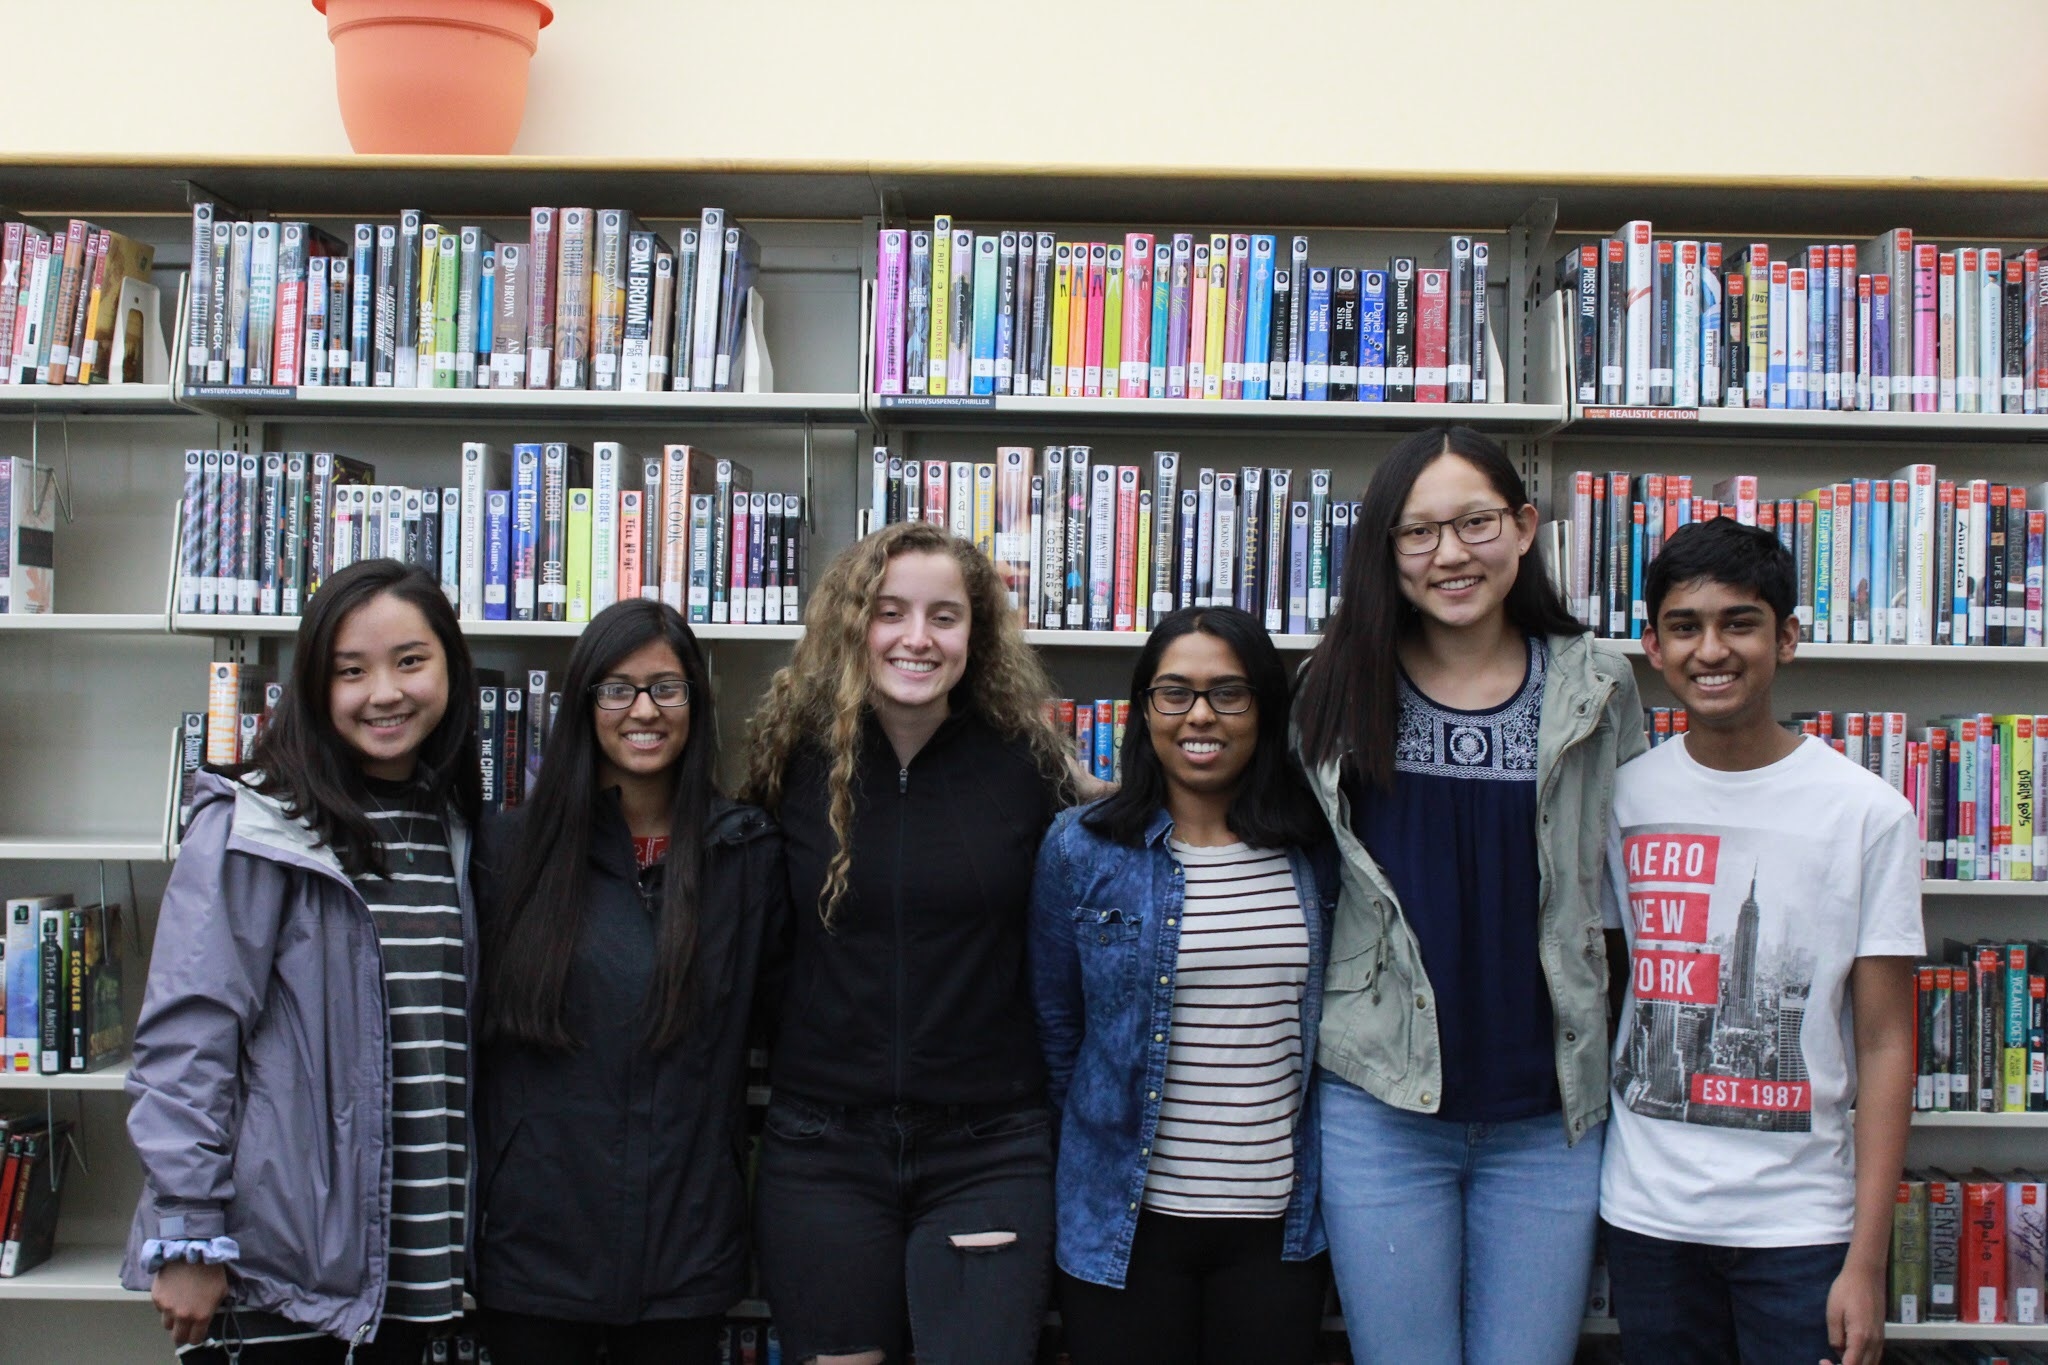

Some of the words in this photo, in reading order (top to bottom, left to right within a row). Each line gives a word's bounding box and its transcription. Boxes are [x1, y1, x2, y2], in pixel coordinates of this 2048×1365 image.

[563, 239, 583, 277] BROWN
[631, 252, 649, 274] AN
[937, 252, 945, 275] RUFF
[503, 264, 516, 284] DAN
[602, 251, 617, 302] BROWN
[1474, 280, 1485, 296] RED
[1582, 267, 1596, 294] PRESS
[2038, 265, 2048, 308] BIFOCAL
[76, 289, 88, 312] Great
[213, 266, 224, 312] REALITY
[283, 286, 297, 301] THE
[354, 274, 370, 303] COLD
[376, 293, 385, 311] LOVE
[459, 289, 472, 313] TONY
[503, 284, 515, 318] BROWN
[563, 290, 581, 302] LOST
[628, 276, 648, 325] BROWN
[1397, 280, 1408, 309] Daniel
[1750, 292, 1769, 304] JUST
[191, 292, 208, 320] KEITH
[282, 304, 296, 328] DOUBT
[385, 294, 395, 335] ASSASSIN'S
[558, 304, 586, 316] SYMBOL
[936, 297, 944, 315] BAD
[1003, 266, 1012, 360] REVOLVE
[1289, 297, 1299, 334] SHADOW
[1318, 303, 1328, 332] Daniel
[1336, 306, 1346, 330] Silva
[1344, 300, 1354, 330] Daniel
[1373, 302, 1384, 333] Daniel
[1423, 308, 1433, 330] Silva
[1433, 299, 1444, 330] Daniel
[1475, 302, 1486, 324] BLOOD
[1581, 296, 1596, 319] PLAY
[1661, 300, 1669, 326] Before
[1876, 295, 1885, 321] DRAPER
[73, 312, 84, 336] Death
[190, 321, 207, 347] ABLO
[213, 312, 224, 350] CHECK
[354, 305, 369, 338] CALLS
[375, 318, 385, 350] TREASON
[458, 314, 471, 353] BROADBE
[1309, 309, 1319, 332] Silva
[1363, 311, 1374, 333] Silva
[1396, 311, 1408, 335] Silva
[1898, 304, 1906, 340] WATER
[279, 332, 294, 365] FACTORY
[384, 336, 394, 358] GUIDE
[935, 318, 943, 360] MONKEYS
[1275, 320, 1284, 357] SHADOW
[1288, 337, 1298, 361] CLUB
[1705, 330, 1713, 366] JERICH
[1395, 345, 1406, 392] Messer
[1811, 352, 1823, 371] Julio
[200, 387, 291, 396] MYSTERY/SUSPENSE/THRILLER
[1609, 409, 1656, 418] REALISTIC
[1658, 410, 1697, 419] FICTION
[313, 482, 323, 495] THE
[467, 468, 476, 483] The
[265, 496, 275, 518] STUDY
[467, 484, 476, 503] Hunt
[544, 492, 561, 522] COBEN
[289, 510, 297, 524] LAST
[313, 498, 323, 520] CASE
[466, 504, 475, 515] for
[513, 489, 538, 534] Clancy
[599, 493, 610, 523] COBEN
[646, 494, 654, 527] COMPASS
[1096, 497, 1109, 522] KNOW
[1917, 506, 1926, 521] Me
[313, 522, 321, 536] FOR
[466, 516, 475, 532] RED
[625, 518, 636, 540] TELL
[667, 501, 684, 545] COOK
[716, 526, 725, 539] the
[1055, 519, 1065, 541] THE
[1182, 527, 1193, 541] ME,
[1219, 515, 1230, 549] HACKING
[264, 527, 276, 570] Charlotte
[286, 531, 300, 561] August
[465, 533, 474, 569] OCTOBER
[624, 542, 636, 554] NO
[694, 527, 708, 549] ROBIN
[1067, 516, 1077, 563] MONSTERS
[1075, 523, 1086, 556] LITTLE
[1095, 533, 1108, 550] WAS
[1201, 512, 1209, 565] RESTLESS
[1312, 519, 1323, 556] DOUBLE
[1577, 527, 1588, 561] Sound
[1914, 533, 1925, 561] Gayle
[311, 536, 322, 569] Jamie
[490, 541, 501, 572] Games
[623, 557, 636, 571] ONE
[694, 550, 708, 572] COOK
[715, 540, 725, 568] Witness
[1045, 529, 1056, 588] CORNERS
[1095, 553, 1107, 570] YOU
[1182, 547, 1193, 582] MISSING,
[1243, 516, 1258, 588] DEADFALL
[1294, 551, 1302, 568] BLACK
[1801, 535, 1810, 575] NOTHING
[1956, 521, 1968, 589] America
[1993, 555, 2002, 576] LIFE
[2009, 526, 2023, 584] WRECKED
[715, 570, 724, 587] Lied
[1053, 546, 1065, 607] DARKEST
[1219, 549, 1230, 585] HARVARD
[1311, 558, 1322, 586] HELIX
[1801, 577, 1809, 589] TO
[1915, 564, 1925, 602] Forman
[1993, 579, 2002, 590] IS
[481, 738, 493, 756] THE
[480, 757, 494, 801] CIPHER
[1934, 759, 1942, 788] Lottery
[2016, 769, 2033, 800] OSTRICH
[2016, 802, 2032, 827] BOYS
[1628, 841, 1705, 878] AERO
[44, 955, 57, 984] TASTE
[71, 950, 82, 1012] SCOWLER
[1632, 956, 1696, 996] ORK
[46, 988, 55, 1005] FOR
[2011, 976, 2024, 1019] VIGILANTE
[44, 1007, 57, 1047] MONSTERS
[1955, 1014, 1963, 1034] LAST
[1983, 1006, 1992, 1035] CRASH
[2010, 1020, 2023, 1049] POETS
[1983, 1036, 1992, 1053] AND
[1983, 1055, 1992, 1078] BURN
[1934, 1189, 1955, 1281] IDENTICAL
